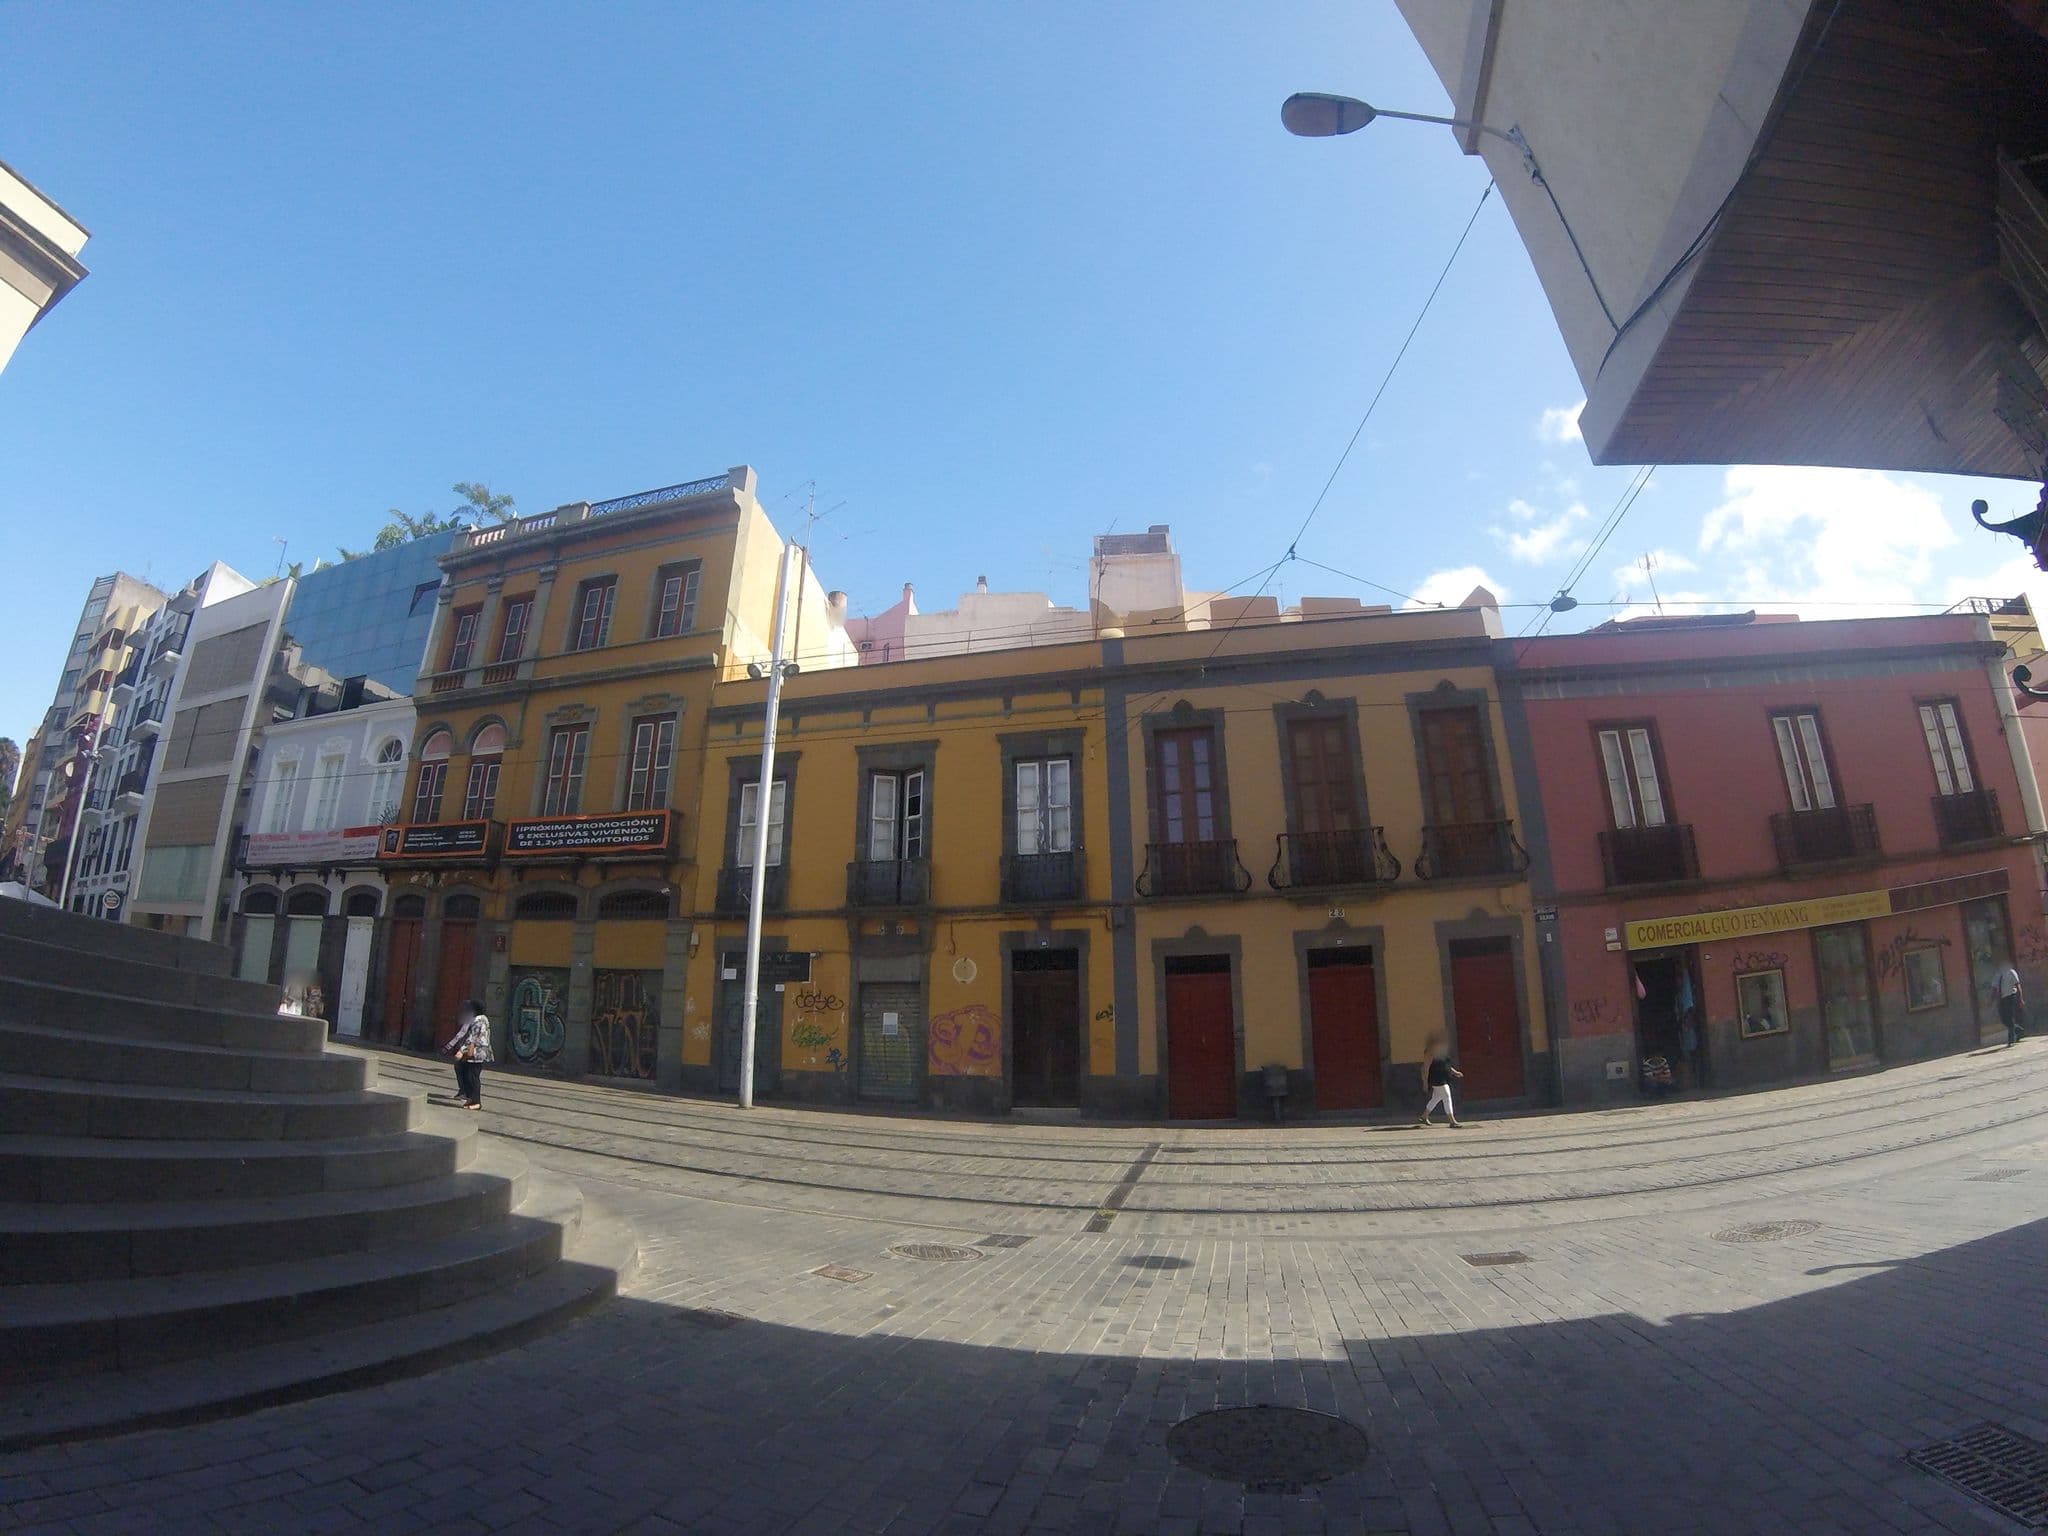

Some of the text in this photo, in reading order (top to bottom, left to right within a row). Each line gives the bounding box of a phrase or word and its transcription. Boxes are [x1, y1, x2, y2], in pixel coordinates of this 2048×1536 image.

[526, 830, 589, 839] EXCLUSIVAS
[591, 826, 655, 837] VIVIENDAS
[566, 834, 650, 845] DORMITORIOS
[1637, 919, 1710, 943] COMERCIAL
[1711, 914, 1741, 935] GUO
